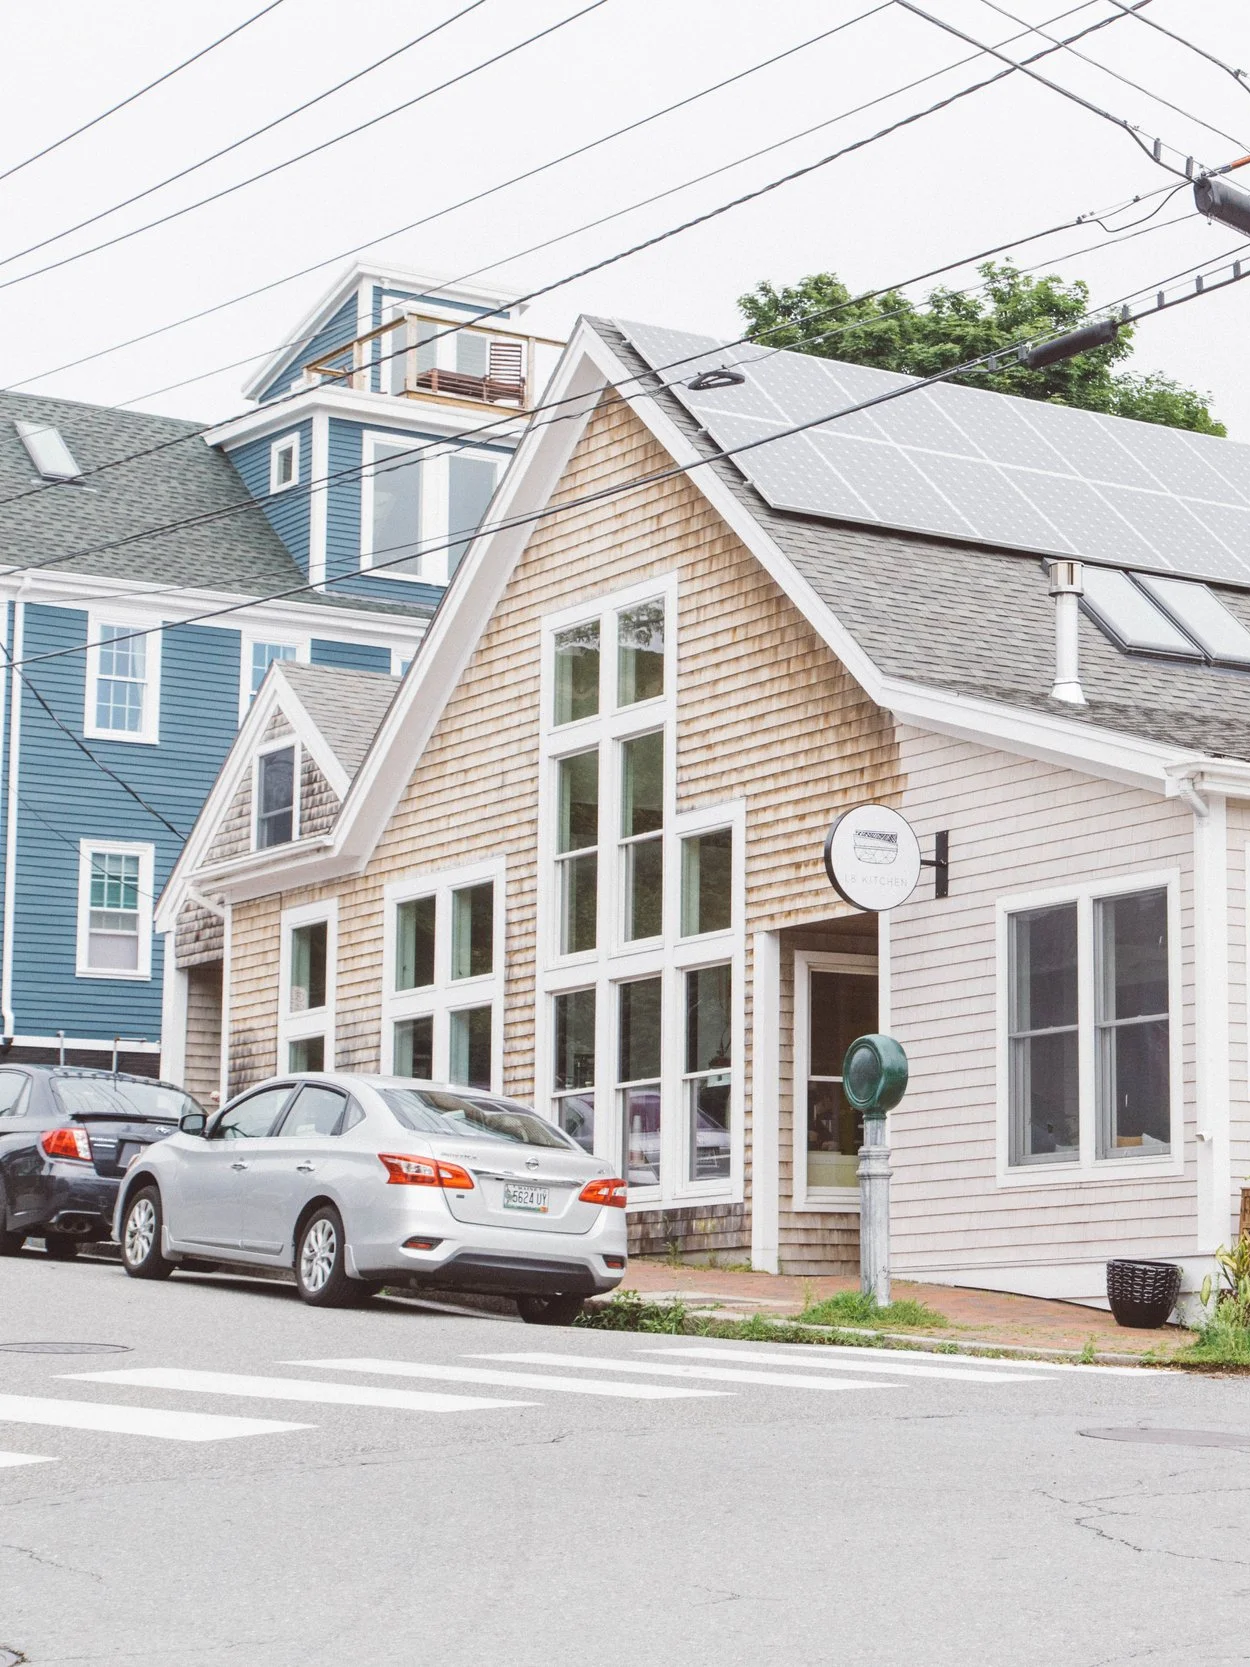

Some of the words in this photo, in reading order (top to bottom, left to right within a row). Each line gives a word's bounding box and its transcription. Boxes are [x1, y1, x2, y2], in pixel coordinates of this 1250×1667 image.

[862, 875, 908, 887] KITCHEN
[512, 1190, 534, 1204] 5624
[536, 1192, 547, 1205] UY
